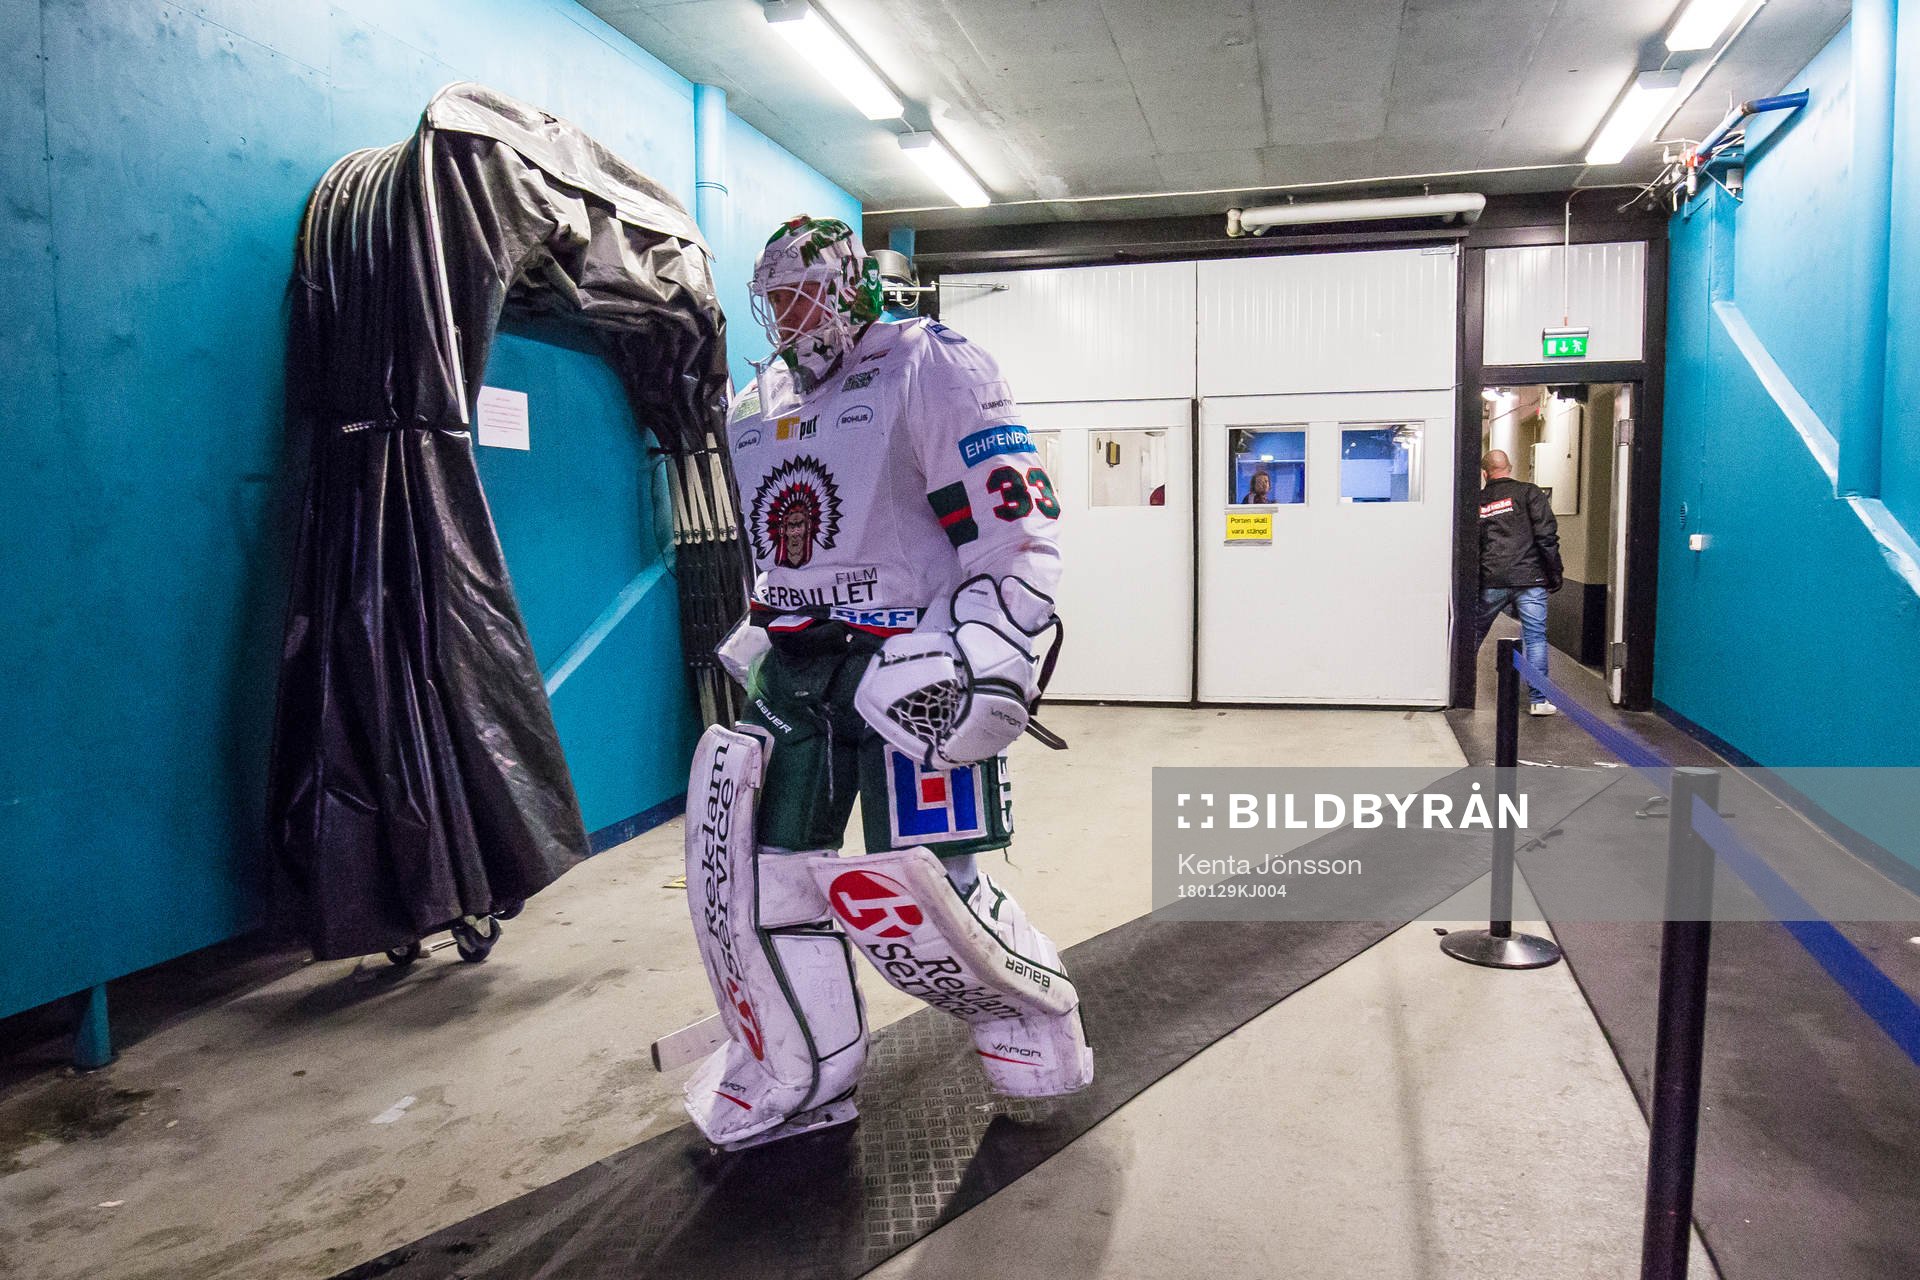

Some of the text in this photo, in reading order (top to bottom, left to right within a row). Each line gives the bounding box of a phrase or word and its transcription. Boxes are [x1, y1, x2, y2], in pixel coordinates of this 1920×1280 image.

[841, 414, 868, 424] BOHUS
[738, 437, 757, 449] BOHUS
[986, 466, 1061, 522] 33
[835, 567, 879, 584] FILM
[768, 580, 878, 608] ERBULLET
[836, 611, 914, 626] SKF
[702, 743, 730, 938] Reklam
